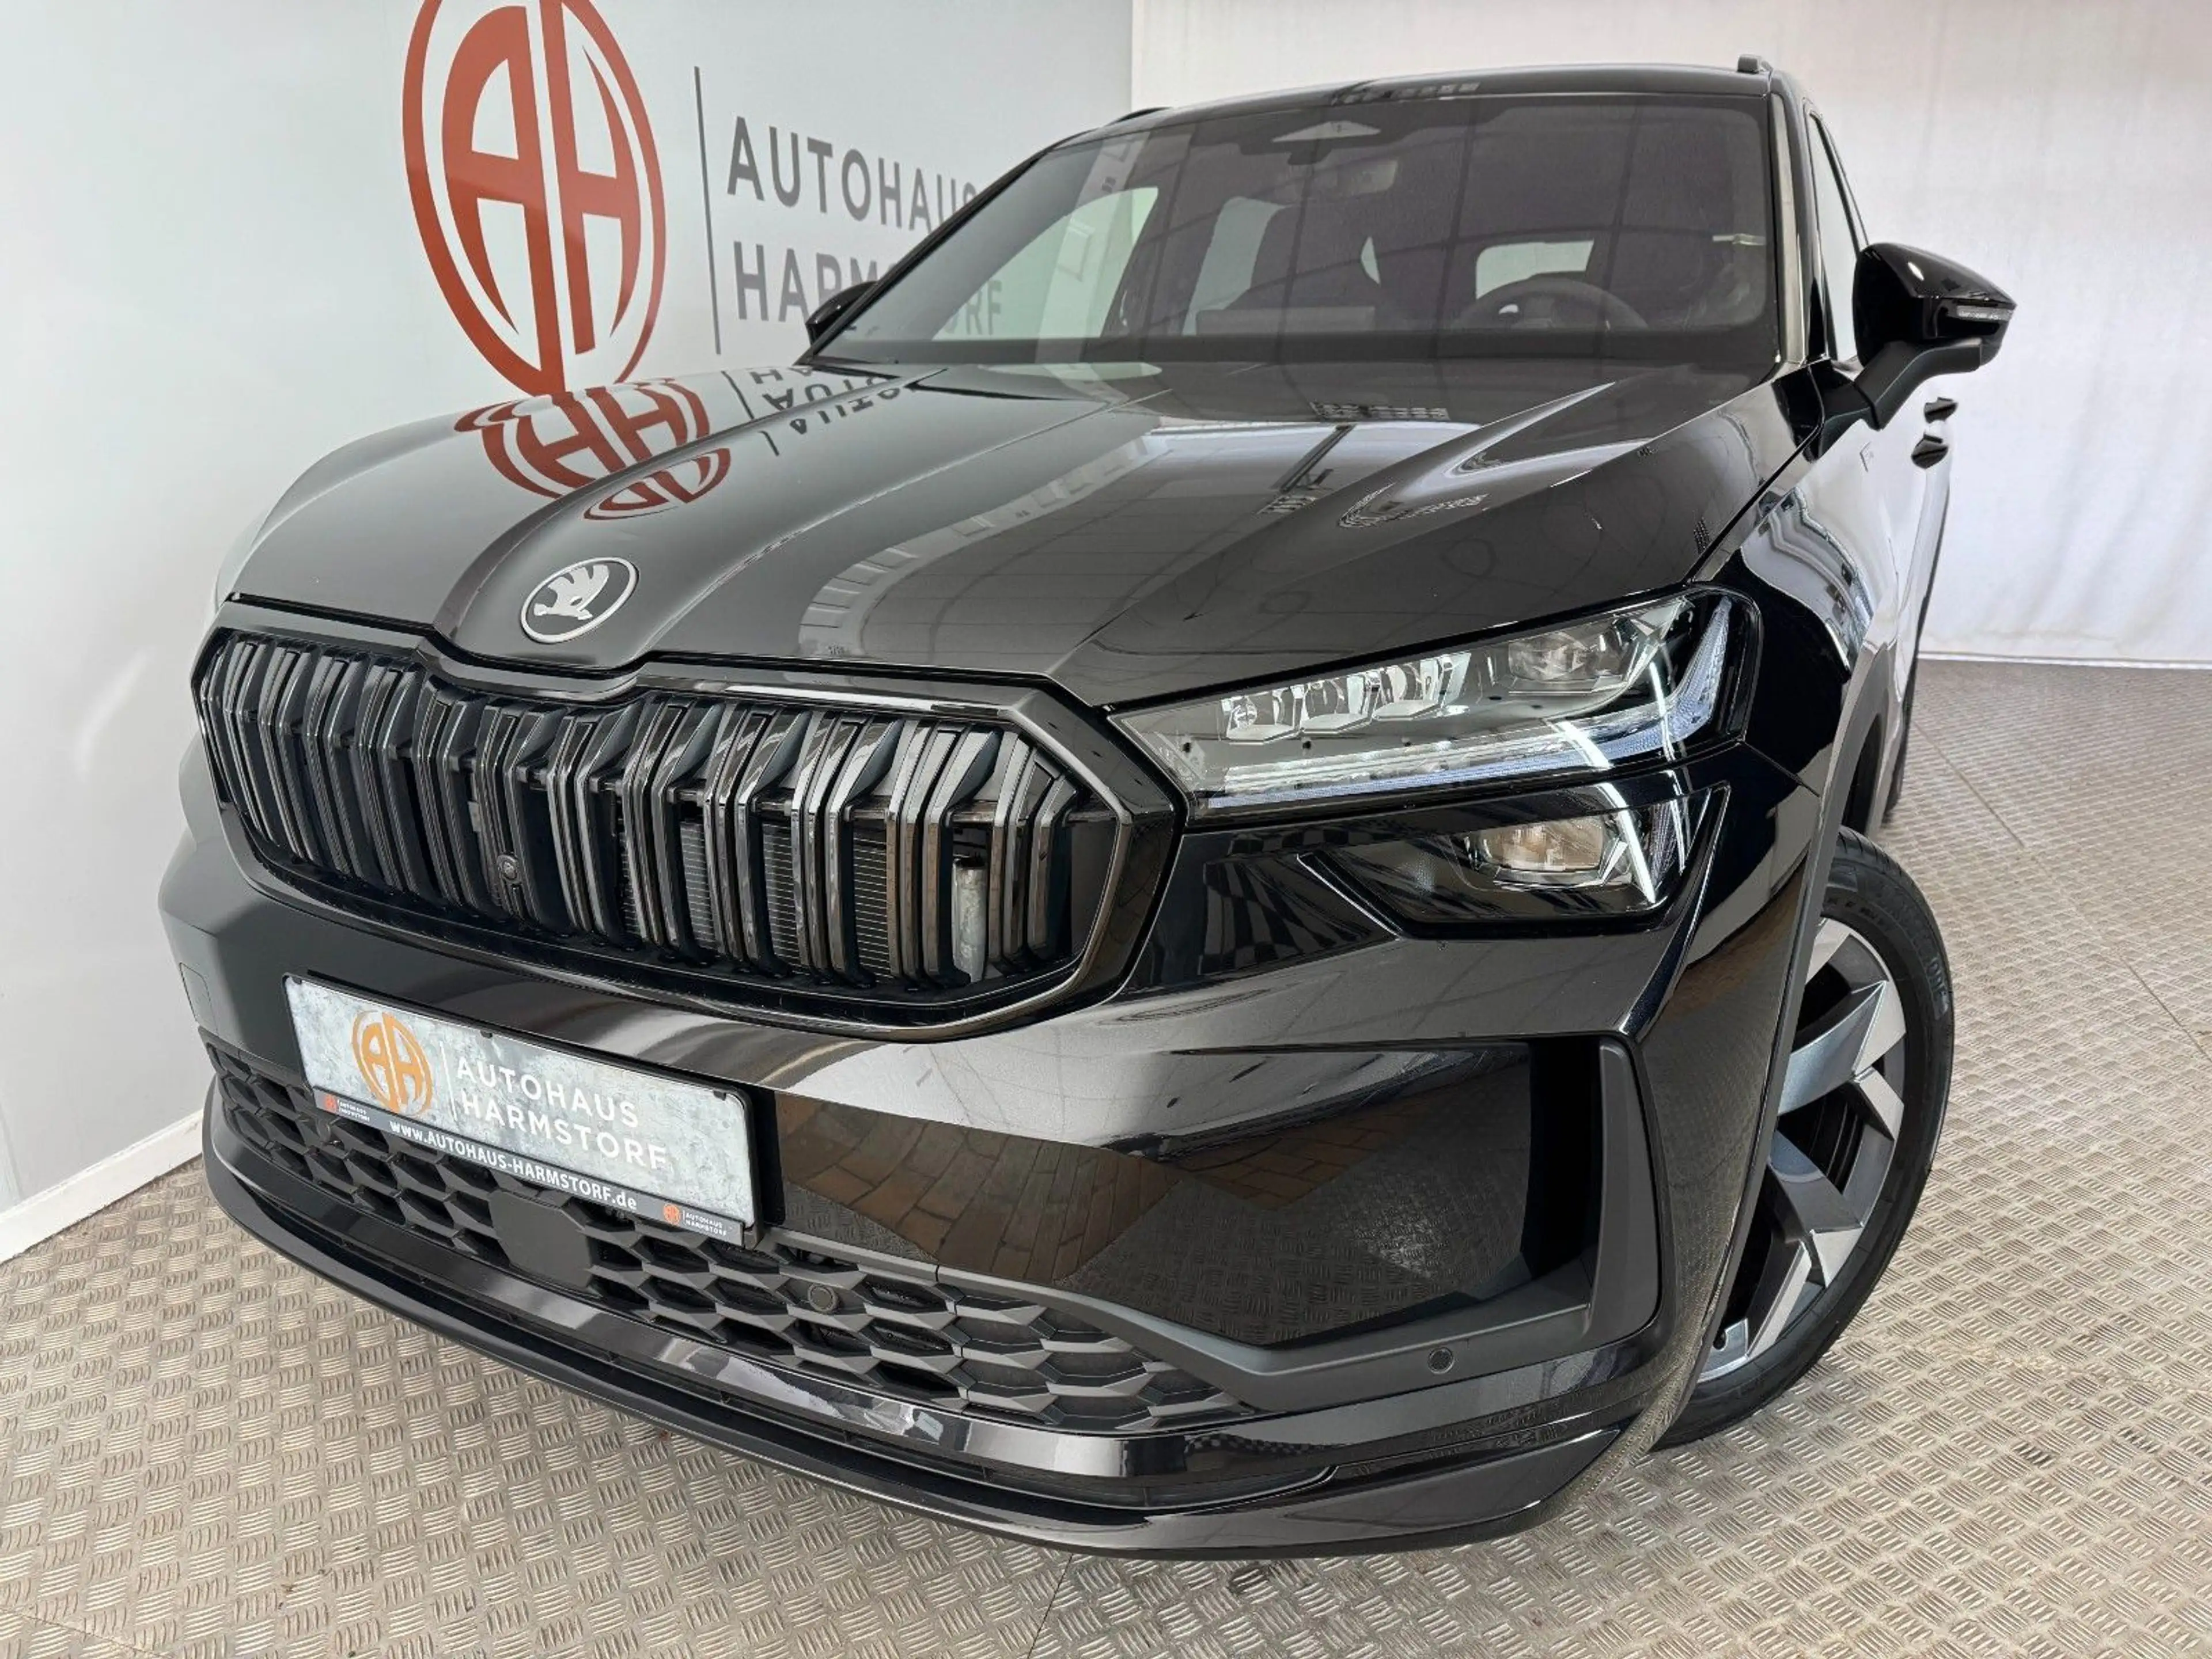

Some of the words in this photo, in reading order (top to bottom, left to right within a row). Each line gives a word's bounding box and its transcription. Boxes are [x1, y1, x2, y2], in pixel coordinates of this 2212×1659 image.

[457, 1056, 638, 1128] AUTOHAUS
[463, 1090, 668, 1170] HARMSTORF
[389, 1120, 637, 1210] www.AUTOHAUS-HARMSTORF.de
